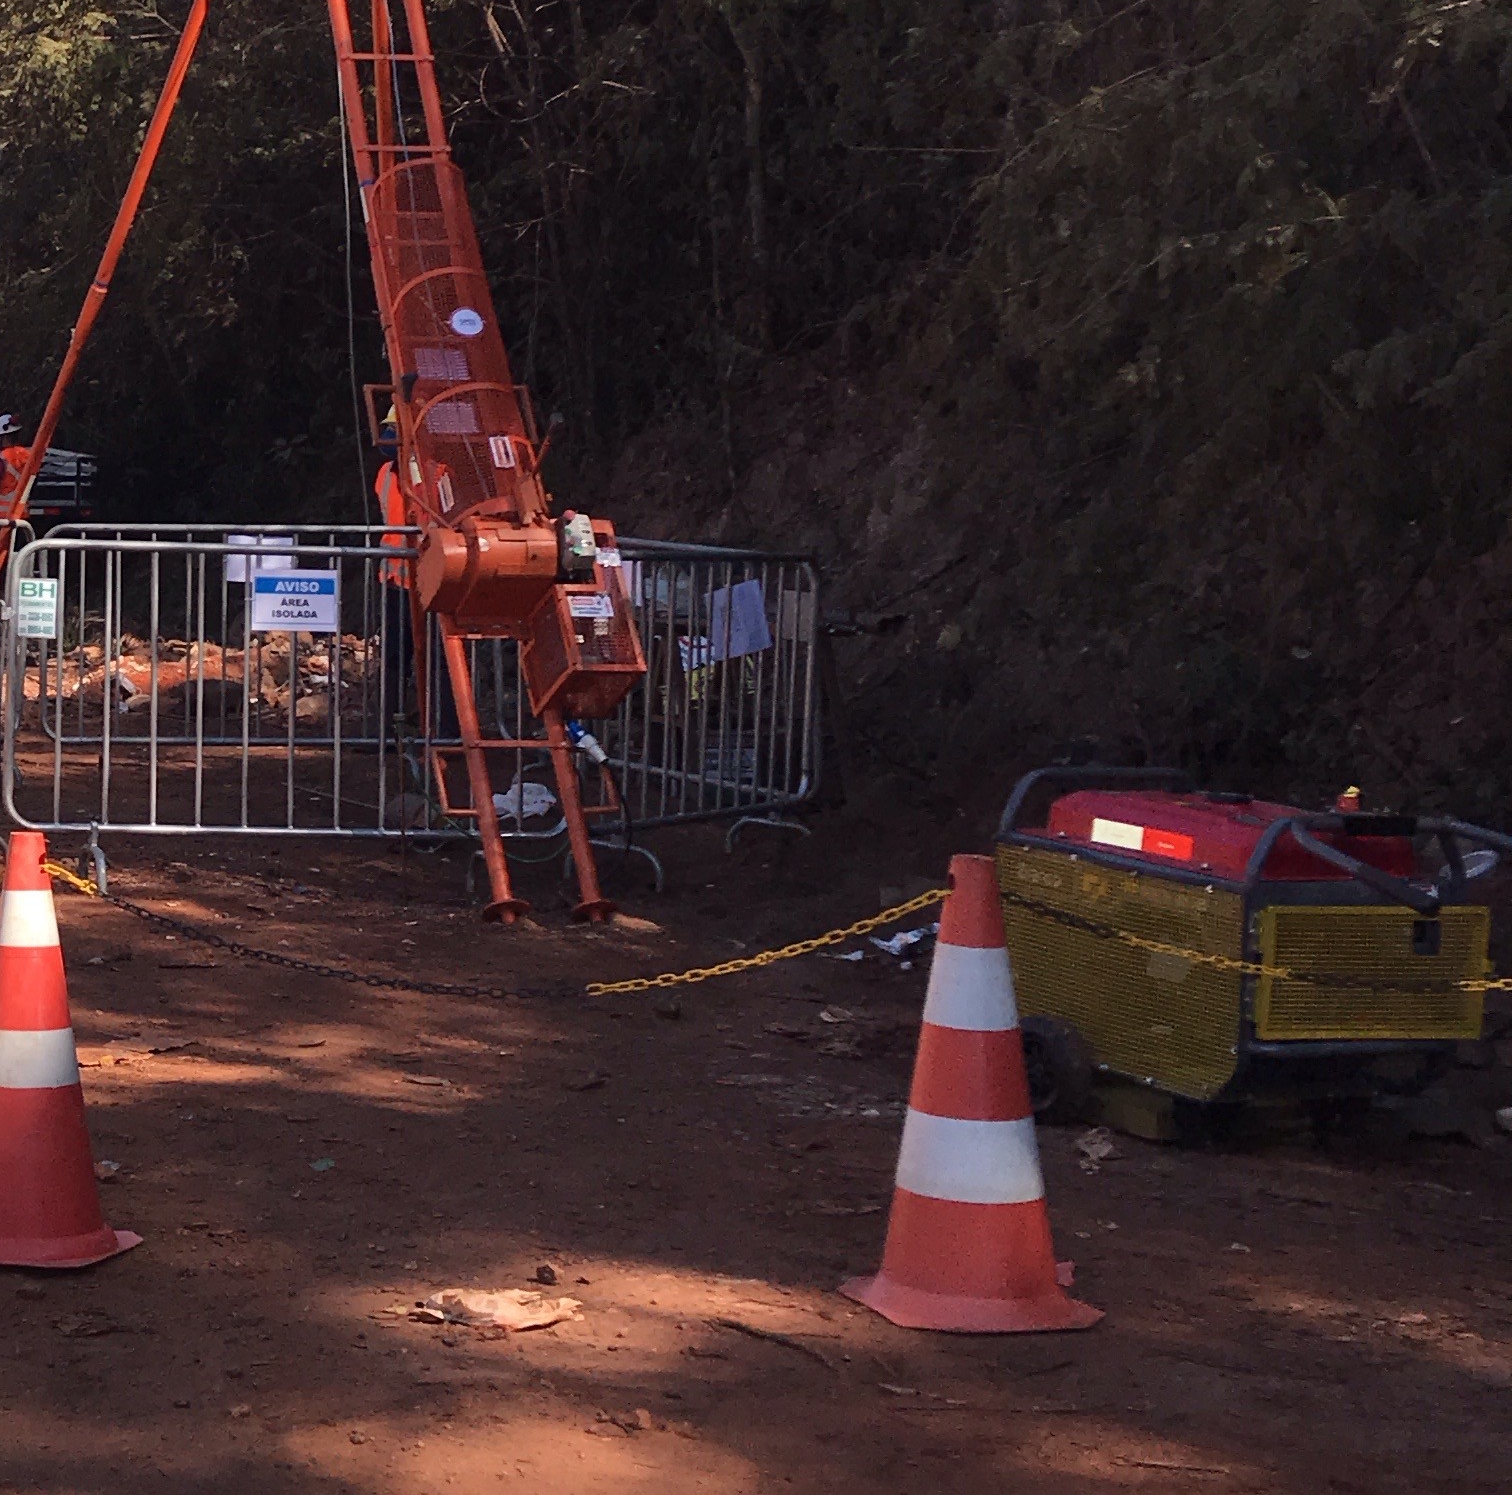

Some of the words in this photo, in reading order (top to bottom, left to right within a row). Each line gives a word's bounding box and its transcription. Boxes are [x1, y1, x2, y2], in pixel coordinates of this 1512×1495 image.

[20, 582, 55, 598] BH
[275, 581, 320, 593] AVISO
[280, 597, 310, 607] ÁREA
[271, 609, 318, 619] ISOLADA
